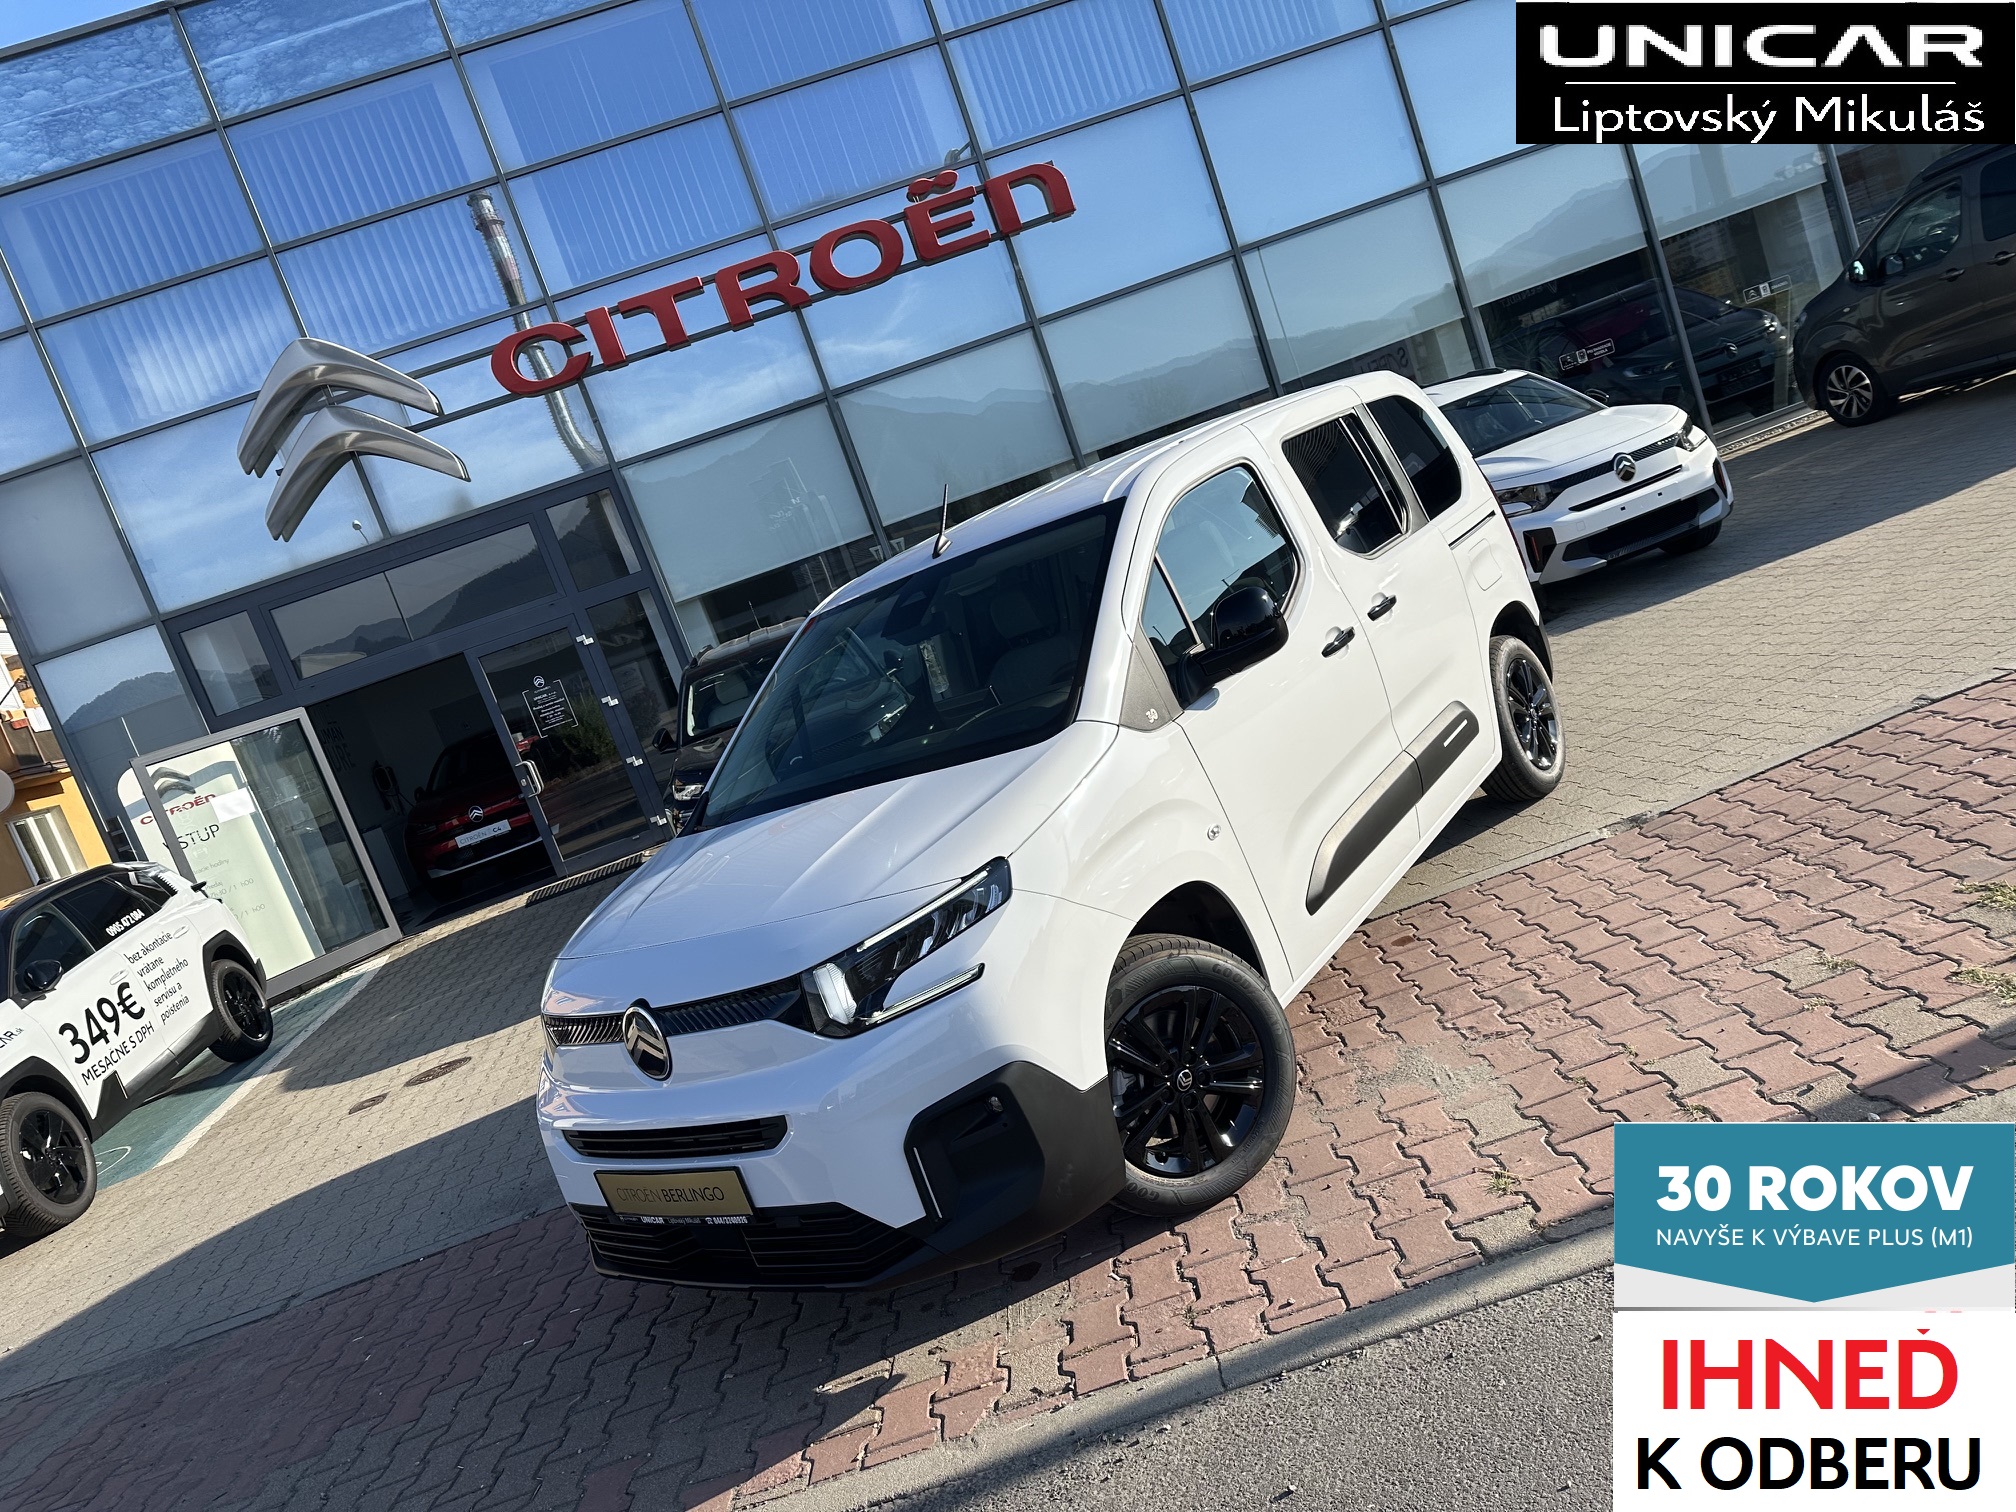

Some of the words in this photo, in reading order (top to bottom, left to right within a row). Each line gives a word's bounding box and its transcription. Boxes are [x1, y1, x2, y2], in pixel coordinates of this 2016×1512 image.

[490, 162, 1077, 397] CITROËN
[1145, 708, 1158, 723] 30
[123, 951, 143, 964] bez
[143, 958, 189, 992] kompletného
[153, 986, 178, 1007] servisu
[160, 994, 190, 1026] poistenia
[58, 982, 146, 1064] 349€
[81, 1041, 131, 1086] MESAČNE
[128, 1035, 137, 1049] S
[136, 1021, 155, 1044] DPH
[616, 1186, 661, 1203] CITROËN
[661, 1186, 725, 1203] BERLINGO
